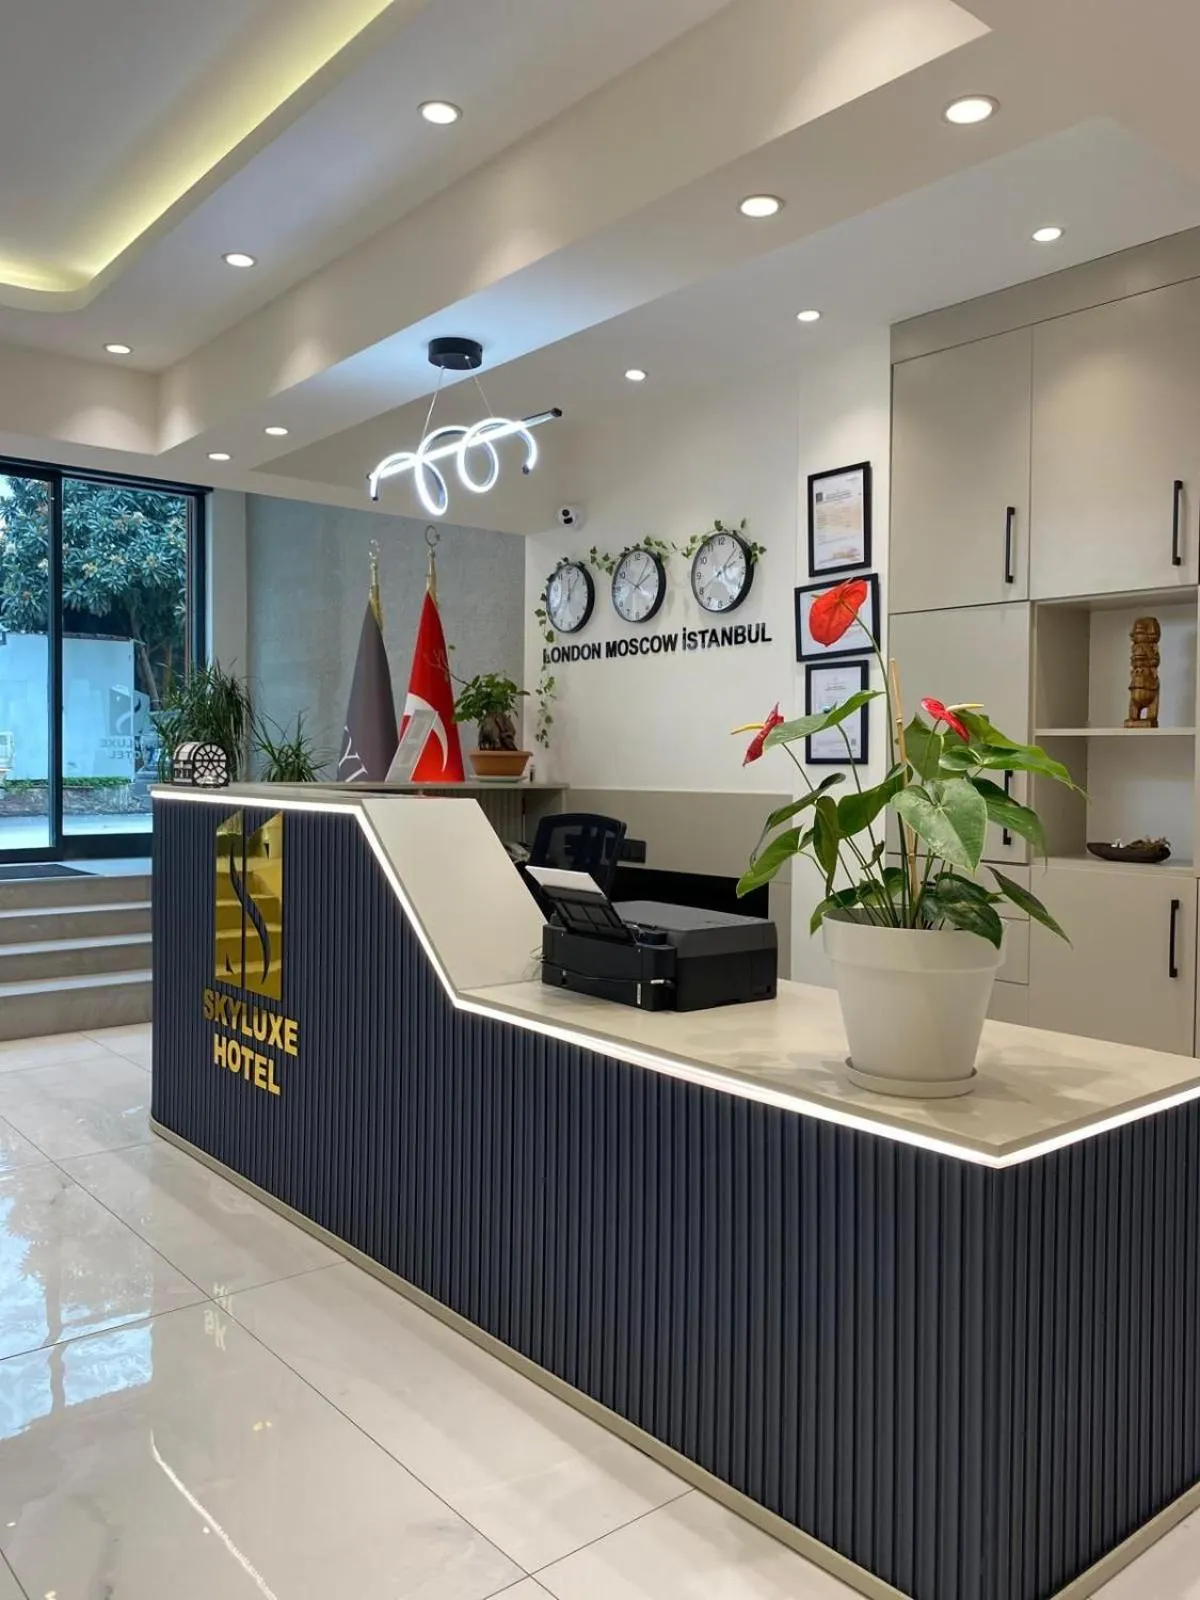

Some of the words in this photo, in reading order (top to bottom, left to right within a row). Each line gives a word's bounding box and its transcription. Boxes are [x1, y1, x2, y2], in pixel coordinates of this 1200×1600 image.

[718, 536, 726, 546] 12
[543, 642, 602, 665] LONDON
[605, 632, 679, 659] MOSCOW
[682, 622, 773, 652] İSTANBUL
[203, 987, 299, 1057] SKYLUXE
[213, 1033, 281, 1096] HOTEL
